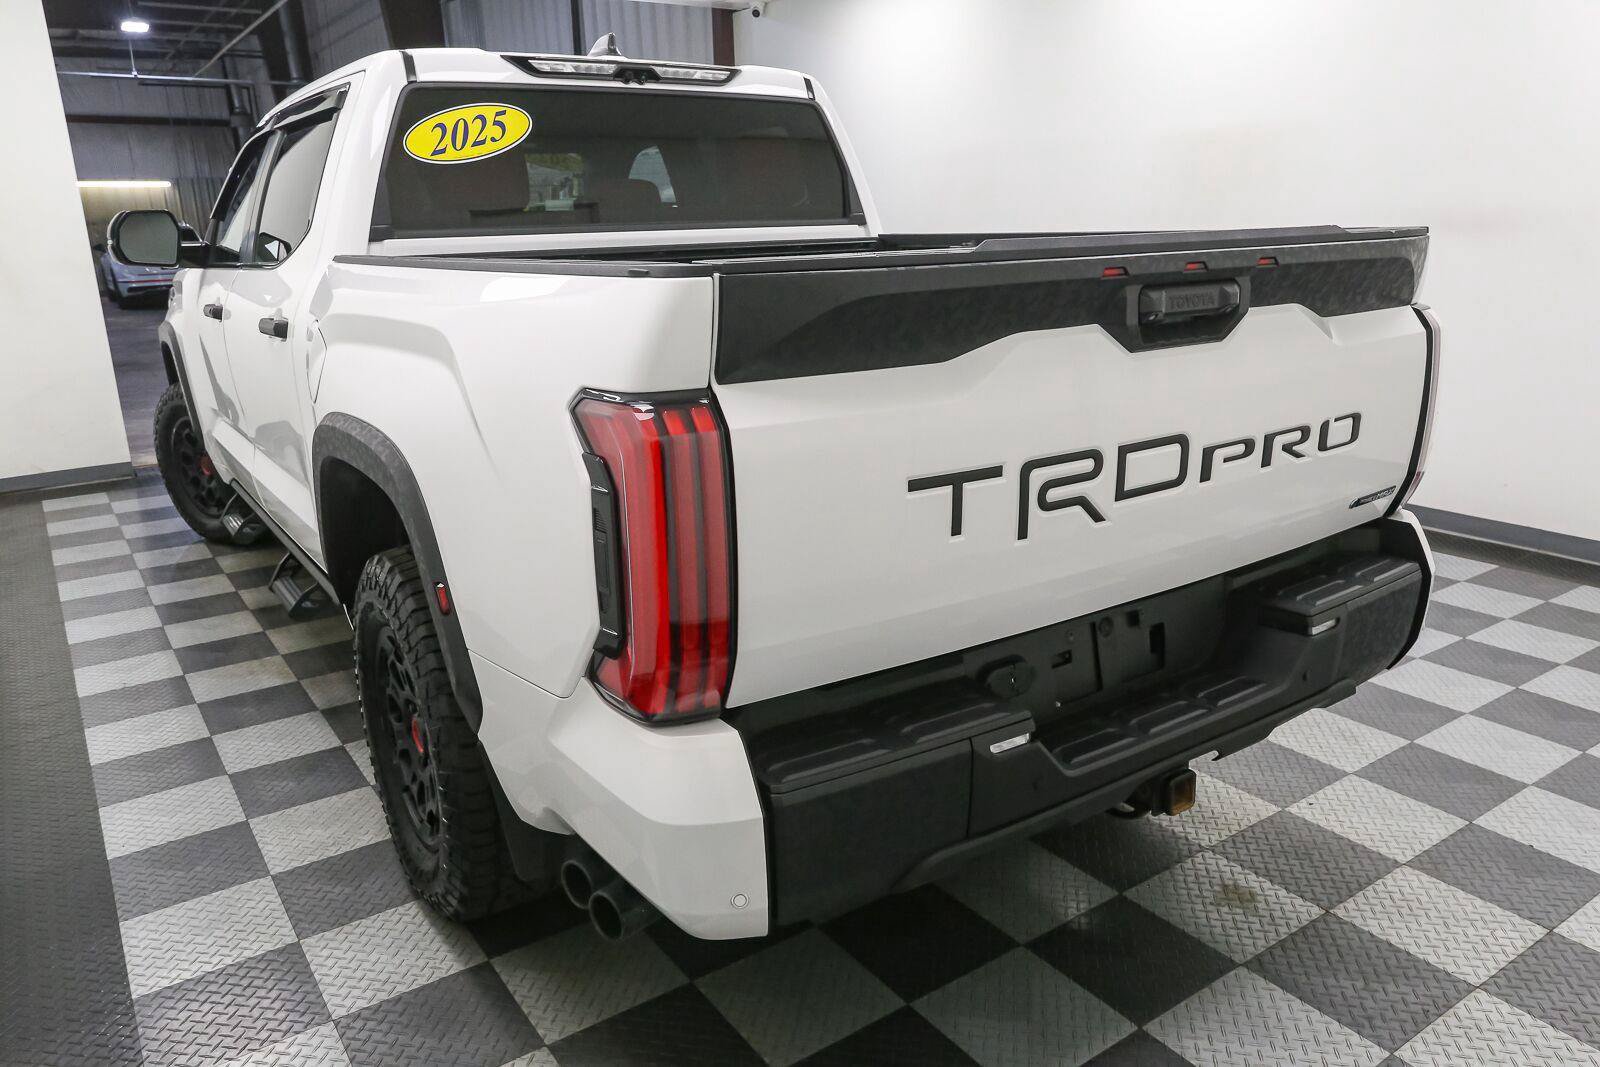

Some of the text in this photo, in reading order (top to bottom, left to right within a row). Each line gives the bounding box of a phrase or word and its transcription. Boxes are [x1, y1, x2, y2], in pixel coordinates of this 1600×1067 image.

[430, 109, 507, 157] 2025
[1169, 292, 1216, 309] TOYOTA
[907, 412, 1362, 541] TRD PRO
